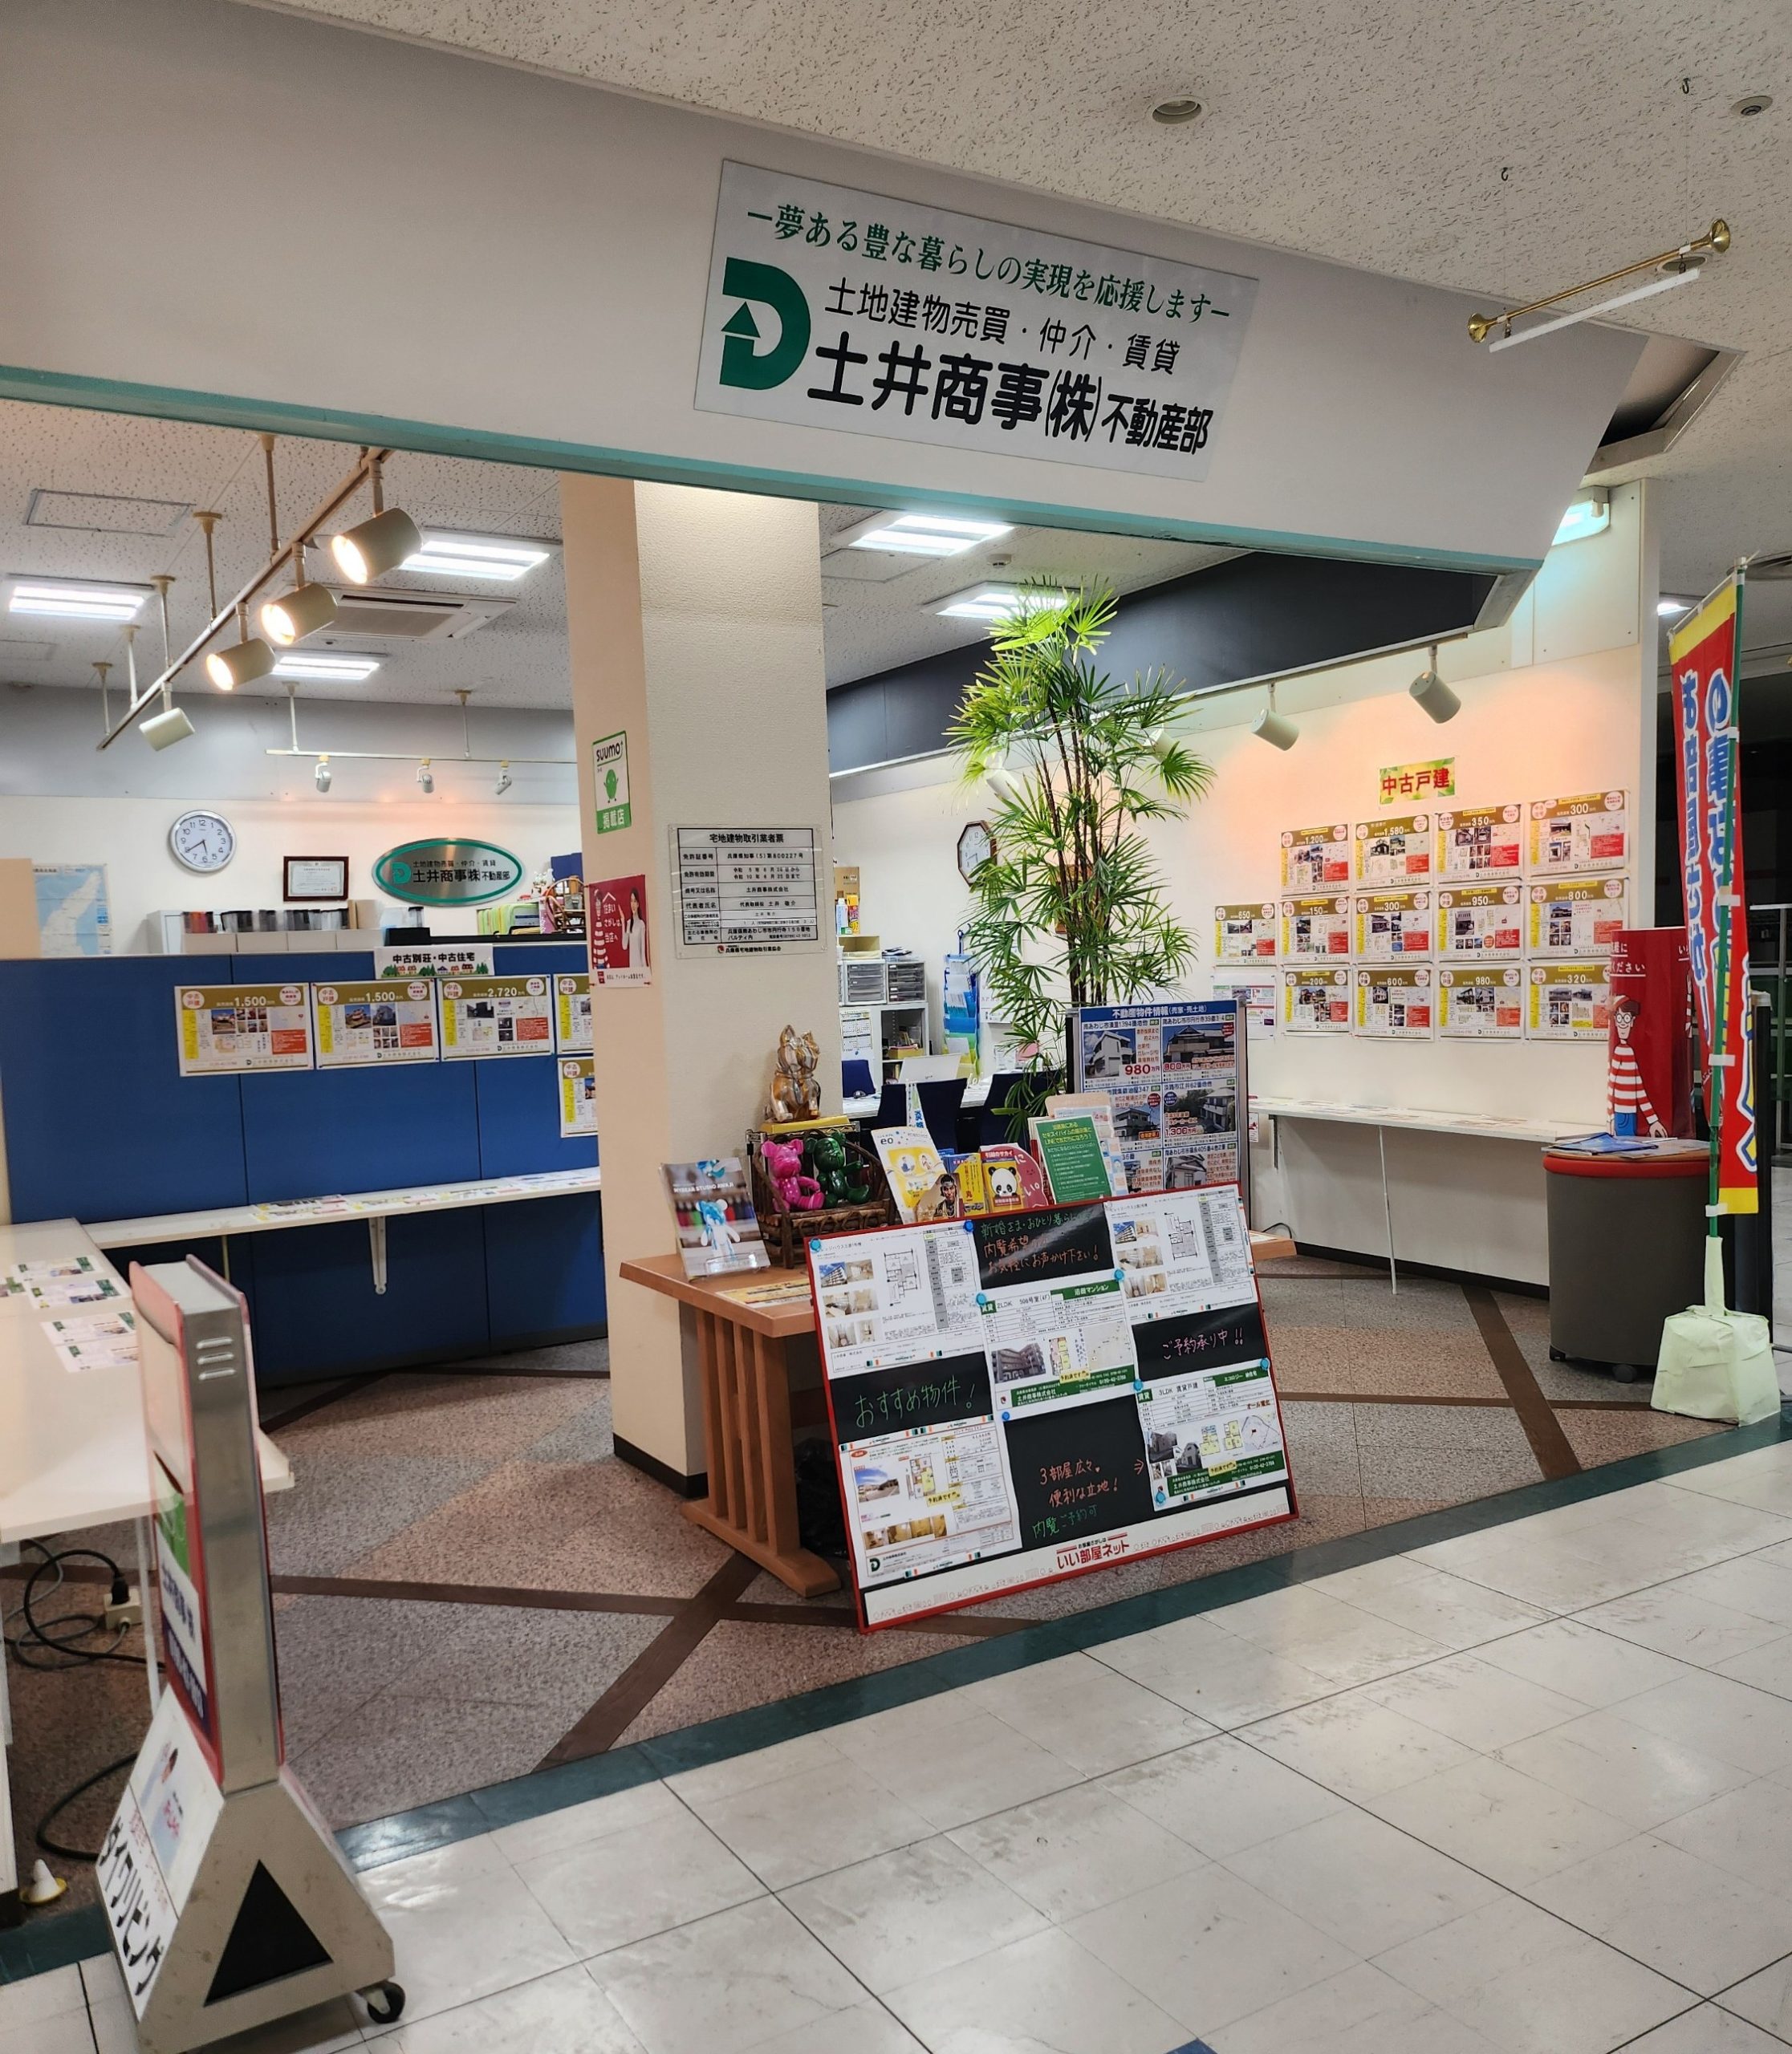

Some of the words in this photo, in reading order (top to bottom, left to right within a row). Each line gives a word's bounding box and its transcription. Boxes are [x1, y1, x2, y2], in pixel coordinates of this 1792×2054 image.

[824, 277, 1180, 375] 土地建物売買・仲介・賃貸
[1383, 767, 1449, 796] 中古戸建
[1571, 804, 1589, 814] 300
[1472, 817, 1489, 826] 350
[709, 834, 784, 842] 宅地建物取引業者票
[1568, 891, 1587, 900] 800
[1472, 896, 1489, 906] 950
[1310, 907, 1323, 915] 150
[1384, 902, 1400, 911] 300
[393, 952, 475, 964] 中古別荘・中古住宅
[1310, 977, 1324, 985] 200
[1387, 977, 1403, 986] 600
[1475, 976, 1490, 985] 980
[1568, 974, 1586, 984] 320
[1125, 1064, 1160, 1076] 980万円
[880, 1137, 894, 1145] eo
[985, 1151, 1014, 1159] 引越のサカイ
[1057, 1540, 1129, 1569] いい部屋ネット
